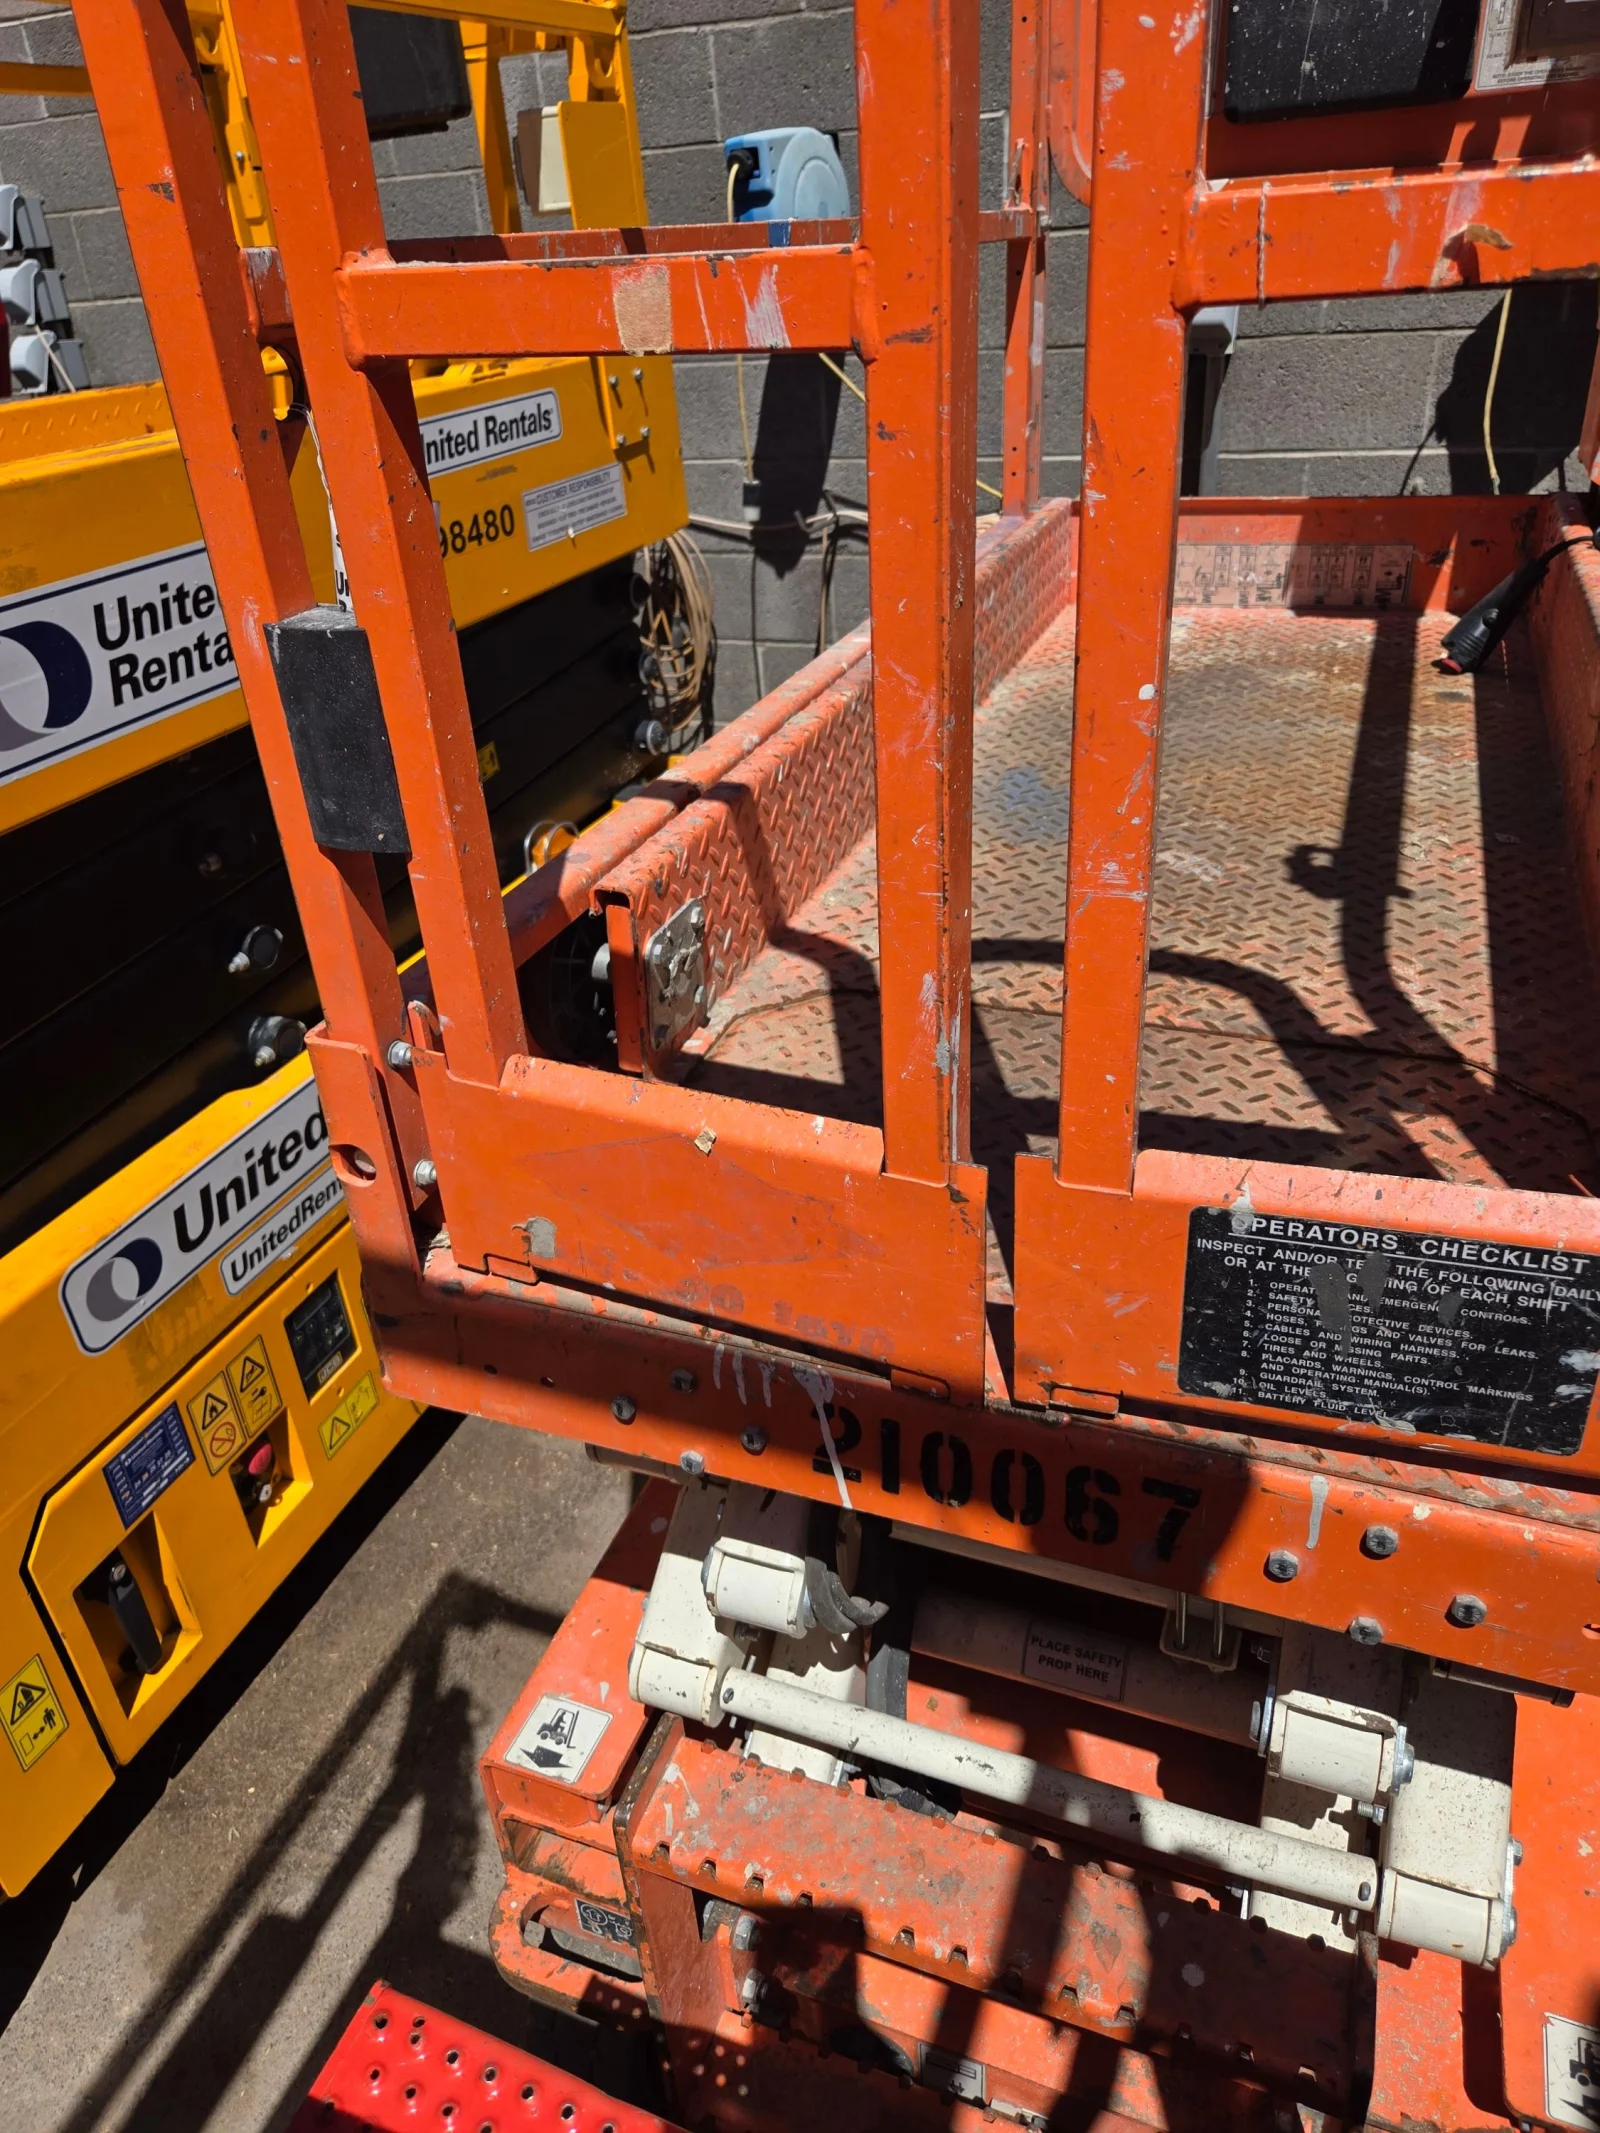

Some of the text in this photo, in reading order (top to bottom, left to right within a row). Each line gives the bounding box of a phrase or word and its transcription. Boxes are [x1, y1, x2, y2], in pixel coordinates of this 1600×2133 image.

[420, 403, 552, 465] nited Rentals
[93, 582, 218, 651] Unite
[108, 630, 236, 708] Renta
[173, 1094, 329, 1253] United
[1197, 1238, 1266, 1257] INSPECT
[1395, 1264, 1430, 1279] THE
[1438, 1270, 1546, 1294] FOLLOWING
[1420, 1239, 1591, 1274] CHECKLIST
[1223, 1256, 1571, 1313] OR AT THE OF EACH SHIFT
[1268, 1292, 1315, 1304] SAFETY
[1267, 1302, 1321, 1317] PERSONA
[1349, 1314, 1410, 1330] OTECTIVE
[1418, 1324, 1474, 1339] DEVICES.
[1269, 1281, 1316, 1294] OPERAT
[1460, 1308, 1532, 1325] CONTROLS.
[1262, 1343, 1295, 1354] TIRES
[1303, 1350, 1327, 1359] AND
[1334, 1354, 1385, 1369] WHEELS.
[1264, 1333, 1302, 1346] LOOSE
[1310, 1340, 1327, 1349] OR
[1334, 1343, 1382, 1358] MSSING
[1390, 1352, 1432, 1365] PARTS.
[1265, 1323, 1311, 1336] CABLES
[1318, 1331, 1343, 1341] AND
[1350, 1336, 1392, 1348] WIRING
[1400, 1343, 1460, 1359] HARNESS.
[1376, 1329, 1401, 1339] AND
[1408, 1333, 1453, 1347] VALVES
[1461, 1341, 1487, 1352] FOR
[1494, 1346, 1539, 1359] LEAKS.
[1258, 1381, 1277, 1391] OIL
[1284, 1385, 1330, 1399] LEVELS.
[1259, 1372, 1324, 1388] GUARDRAIL
[1332, 1383, 1380, 1398] SYSTEM.
[1260, 1362, 1431, 1396] AND OPERATING MANUAL(S).
[1261, 1353, 1325, 1371] PLACARDS,
[1332, 1364, 1396, 1381] WARNINGS,
[1403, 1375, 1461, 1391] CONTROL
[1468, 1385, 1534, 1402] MARKINGS
[1258, 1391, 1306, 1405] BATTERY
[1313, 1399, 1346, 1412] FLUID
[811, 1402, 1203, 1563] 210067
[1031, 1635, 1122, 1668] PLACE SAFETY
[1038, 1654, 1110, 1683] PROP HERE
